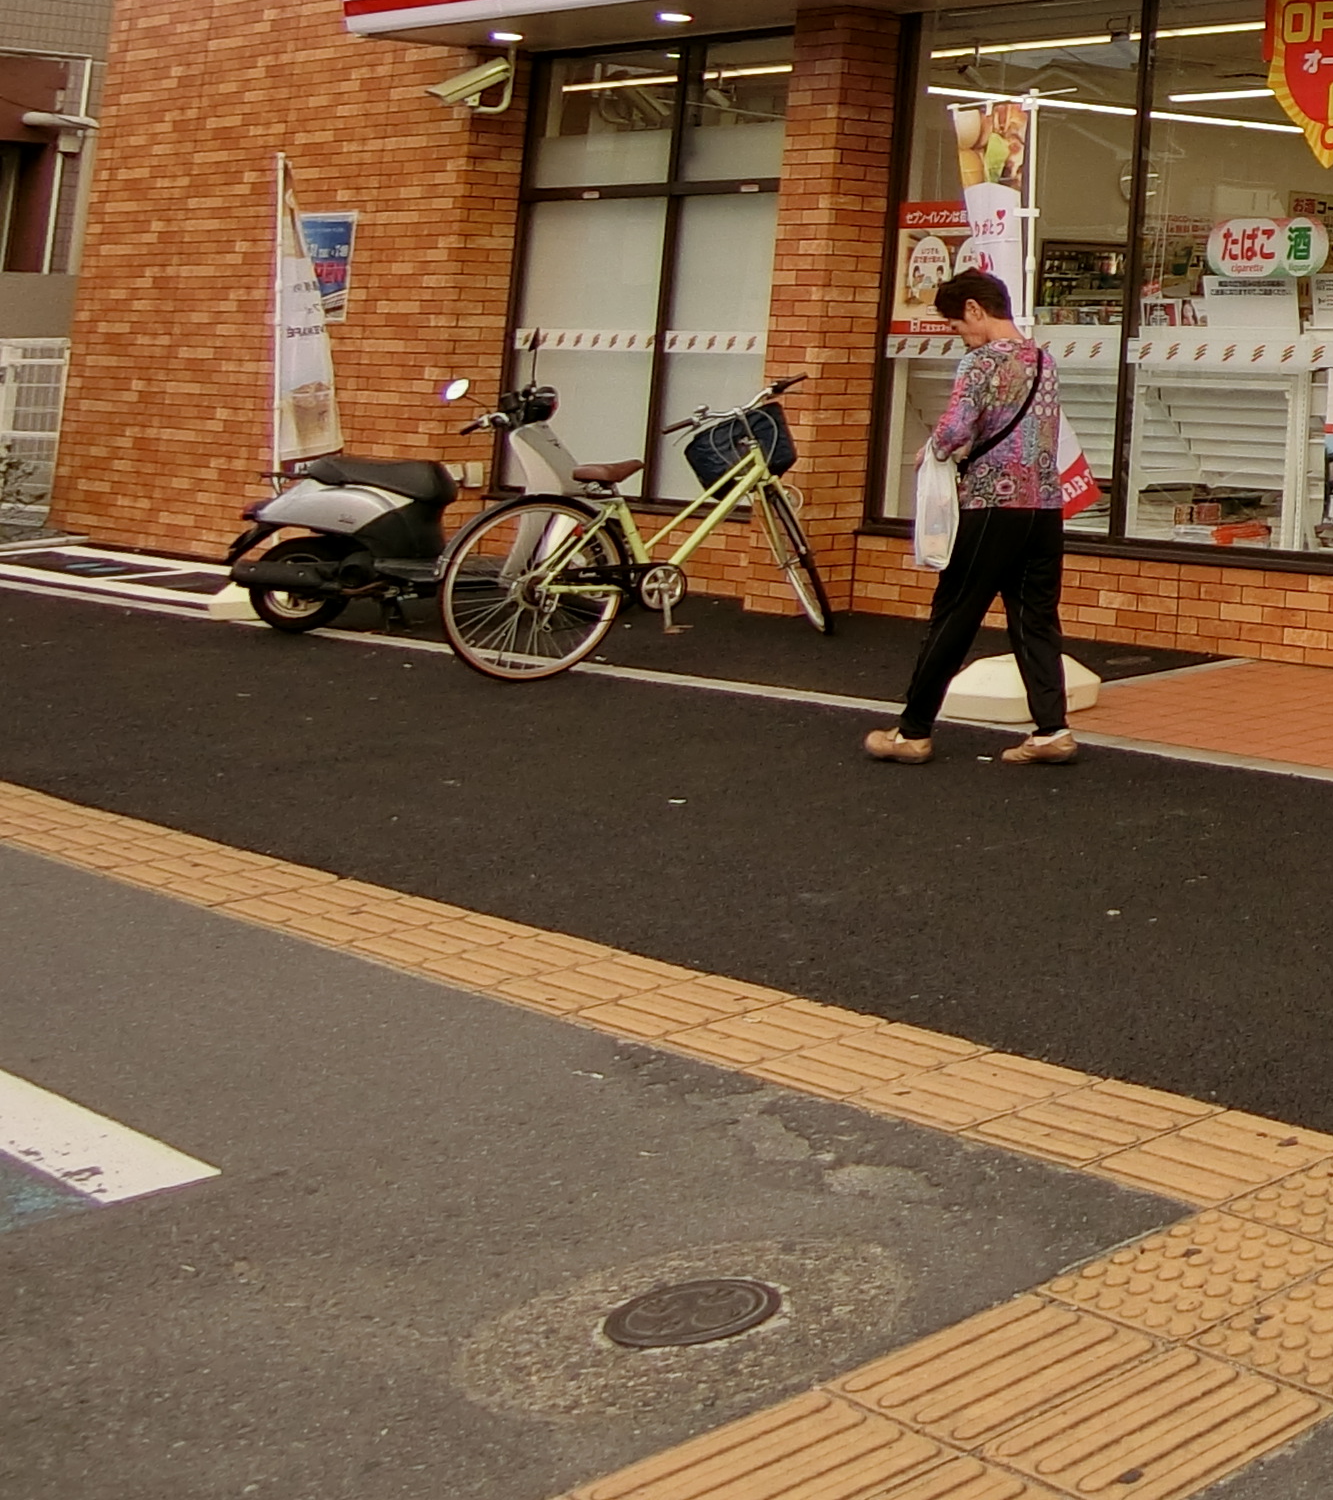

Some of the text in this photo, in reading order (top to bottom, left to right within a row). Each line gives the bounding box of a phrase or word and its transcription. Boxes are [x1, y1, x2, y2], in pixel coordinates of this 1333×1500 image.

[1220, 227, 1276, 262] たばこ
[1286, 225, 1313, 261] 酒
[1231, 263, 1264, 274] cigarette
